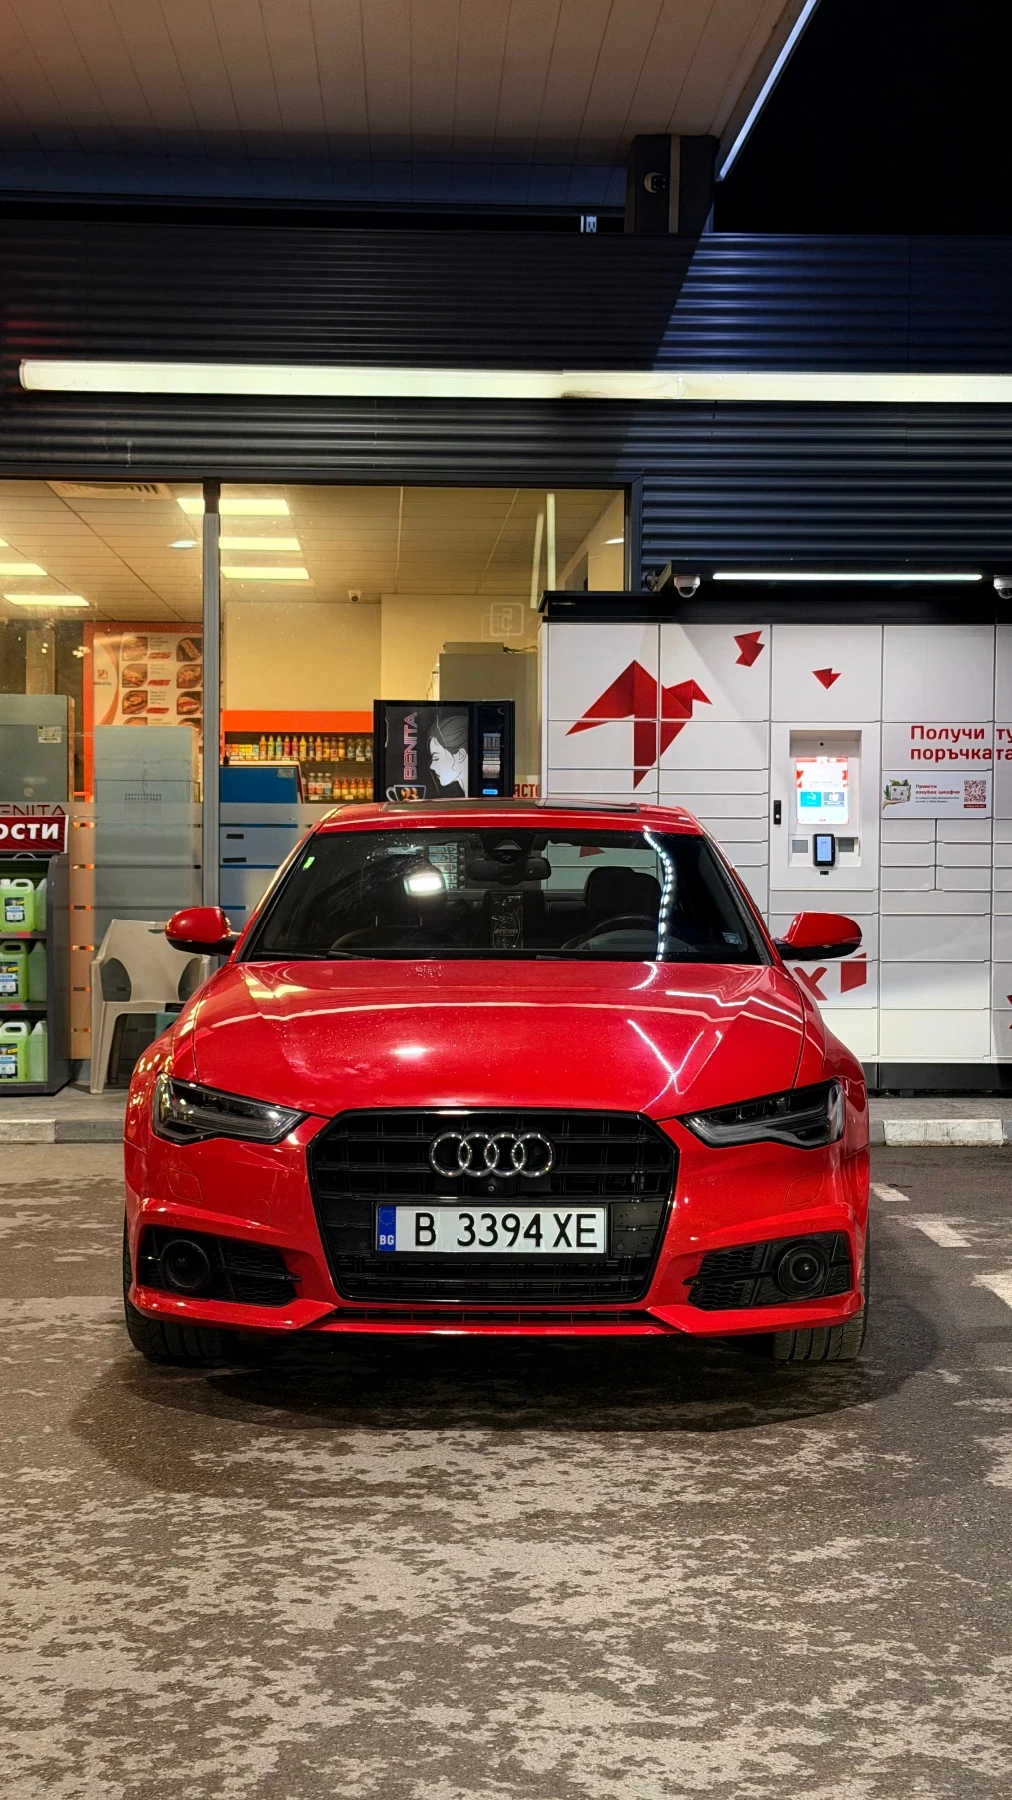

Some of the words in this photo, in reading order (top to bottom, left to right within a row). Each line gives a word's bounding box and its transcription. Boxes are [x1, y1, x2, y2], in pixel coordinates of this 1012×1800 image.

[404, 711, 417, 780] BENITA
[911, 725, 984, 743] Получи
[379, 1235, 395, 1246] BG
[415, 1212, 436, 1246] B
[457, 1213, 542, 1247] 3394
[553, 1213, 597, 1248] XE
